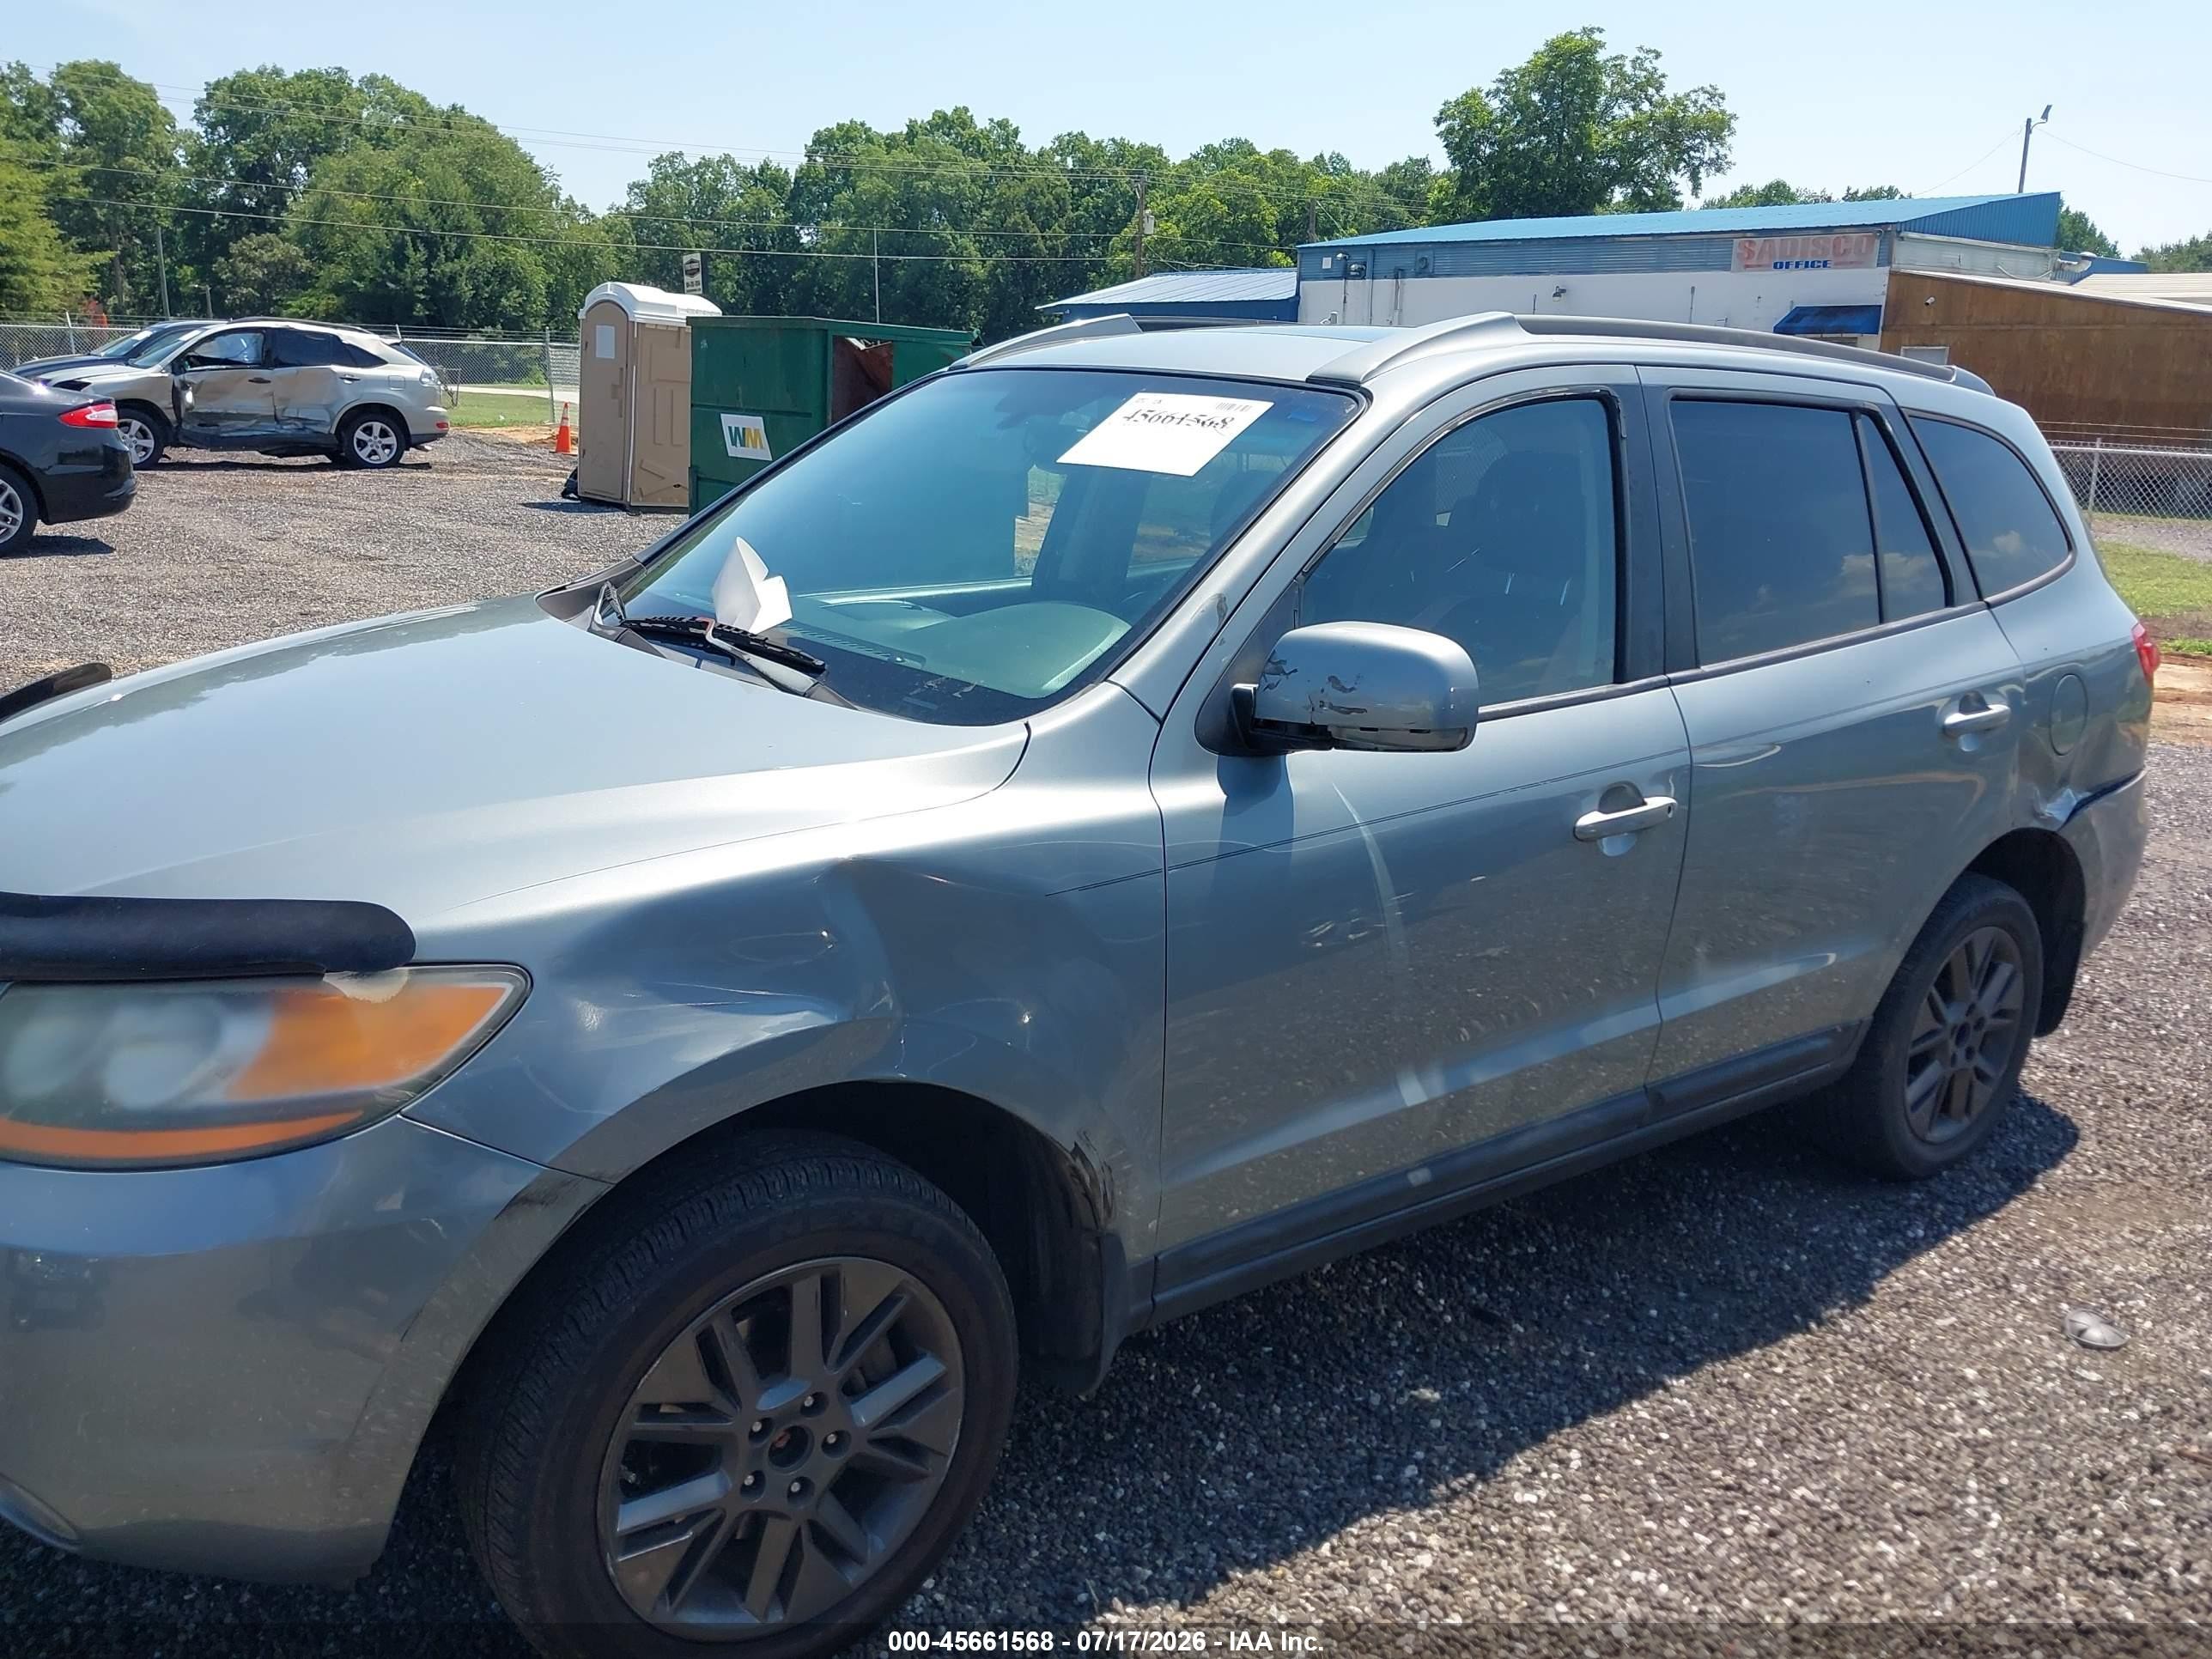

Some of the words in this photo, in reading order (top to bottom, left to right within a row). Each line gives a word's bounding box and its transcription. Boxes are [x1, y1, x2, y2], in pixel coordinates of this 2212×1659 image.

[1738, 235, 1875, 259] SADISCO
[1772, 259, 1832, 270] OFFICE
[1123, 410, 1235, 428] 45661568
[727, 426, 764, 449] WM
